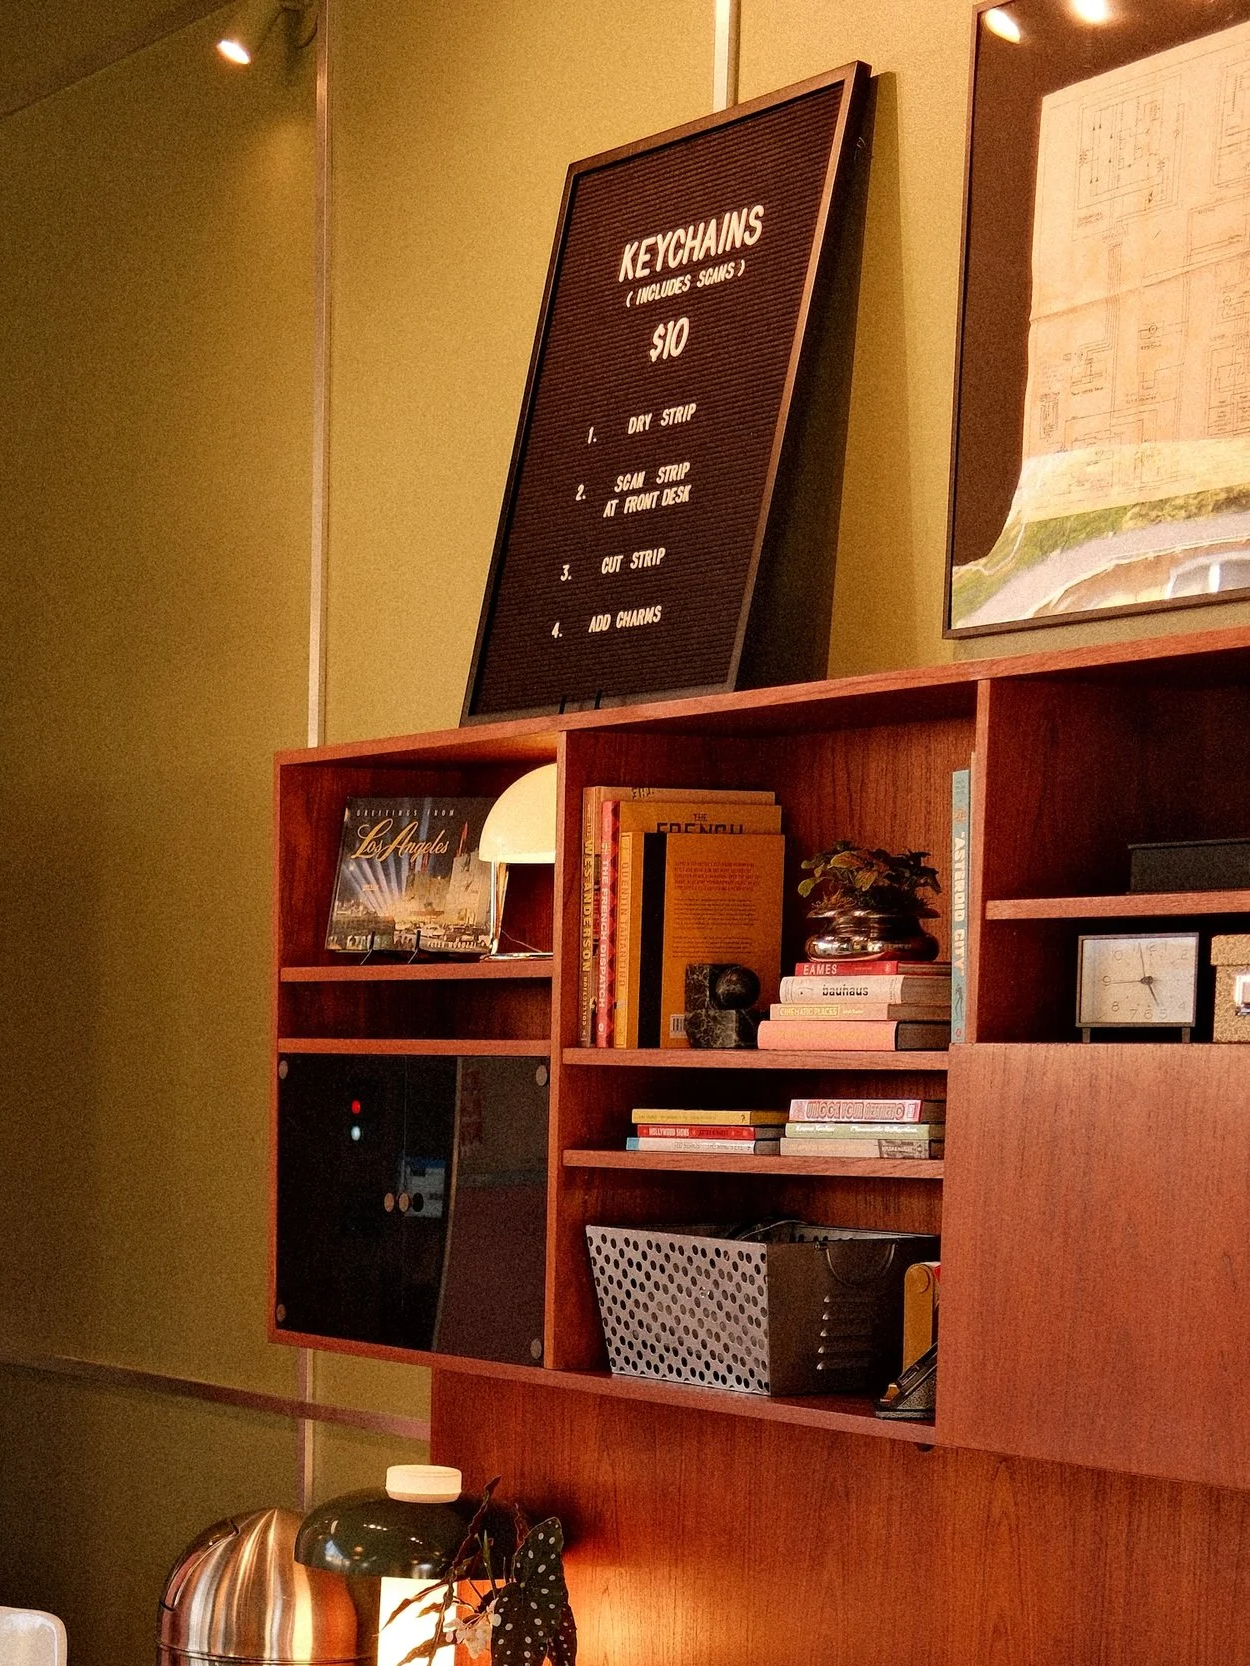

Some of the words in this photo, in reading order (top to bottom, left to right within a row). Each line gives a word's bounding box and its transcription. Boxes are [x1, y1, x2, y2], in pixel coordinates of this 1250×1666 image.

[618, 205, 765, 282] KEYCHAINS
[649, 317, 690, 362] $10
[587, 426, 597, 444] 1.
[627, 410, 652, 435] DRY
[660, 402, 697, 427] STRIP
[575, 484, 586, 501] 2.
[614, 470, 645, 493] SCAN
[657, 462, 691, 486] STRIP
[603, 500, 617, 519] AT
[624, 491, 660, 515] FRONT
[661, 484, 692, 507] DESK
[560, 564, 572, 582] 3.
[601, 554, 623, 575] CUT
[630, 548, 666, 571] STRIP
[551, 620, 562, 639] 4.
[588, 613, 611, 634] ADD
[616, 605, 662, 631] CHARMS
[351, 818, 393, 860] Los
[377, 821, 450, 862] Angeles
[584, 841, 593, 877] WES
[601, 859, 609, 885] THE
[582, 881, 593, 972] ANDERSON
[600, 888, 608, 940] FRENCH
[599, 945, 607, 1008] DISPATCH
[803, 963, 837, 976] EAMES
[822, 984, 869, 996] bauhaus
[780, 1007, 814, 1016] CINEMATIC
[814, 1007, 838, 1016] PLACES
[649, 1127, 675, 1136] HOLLYWOOD
